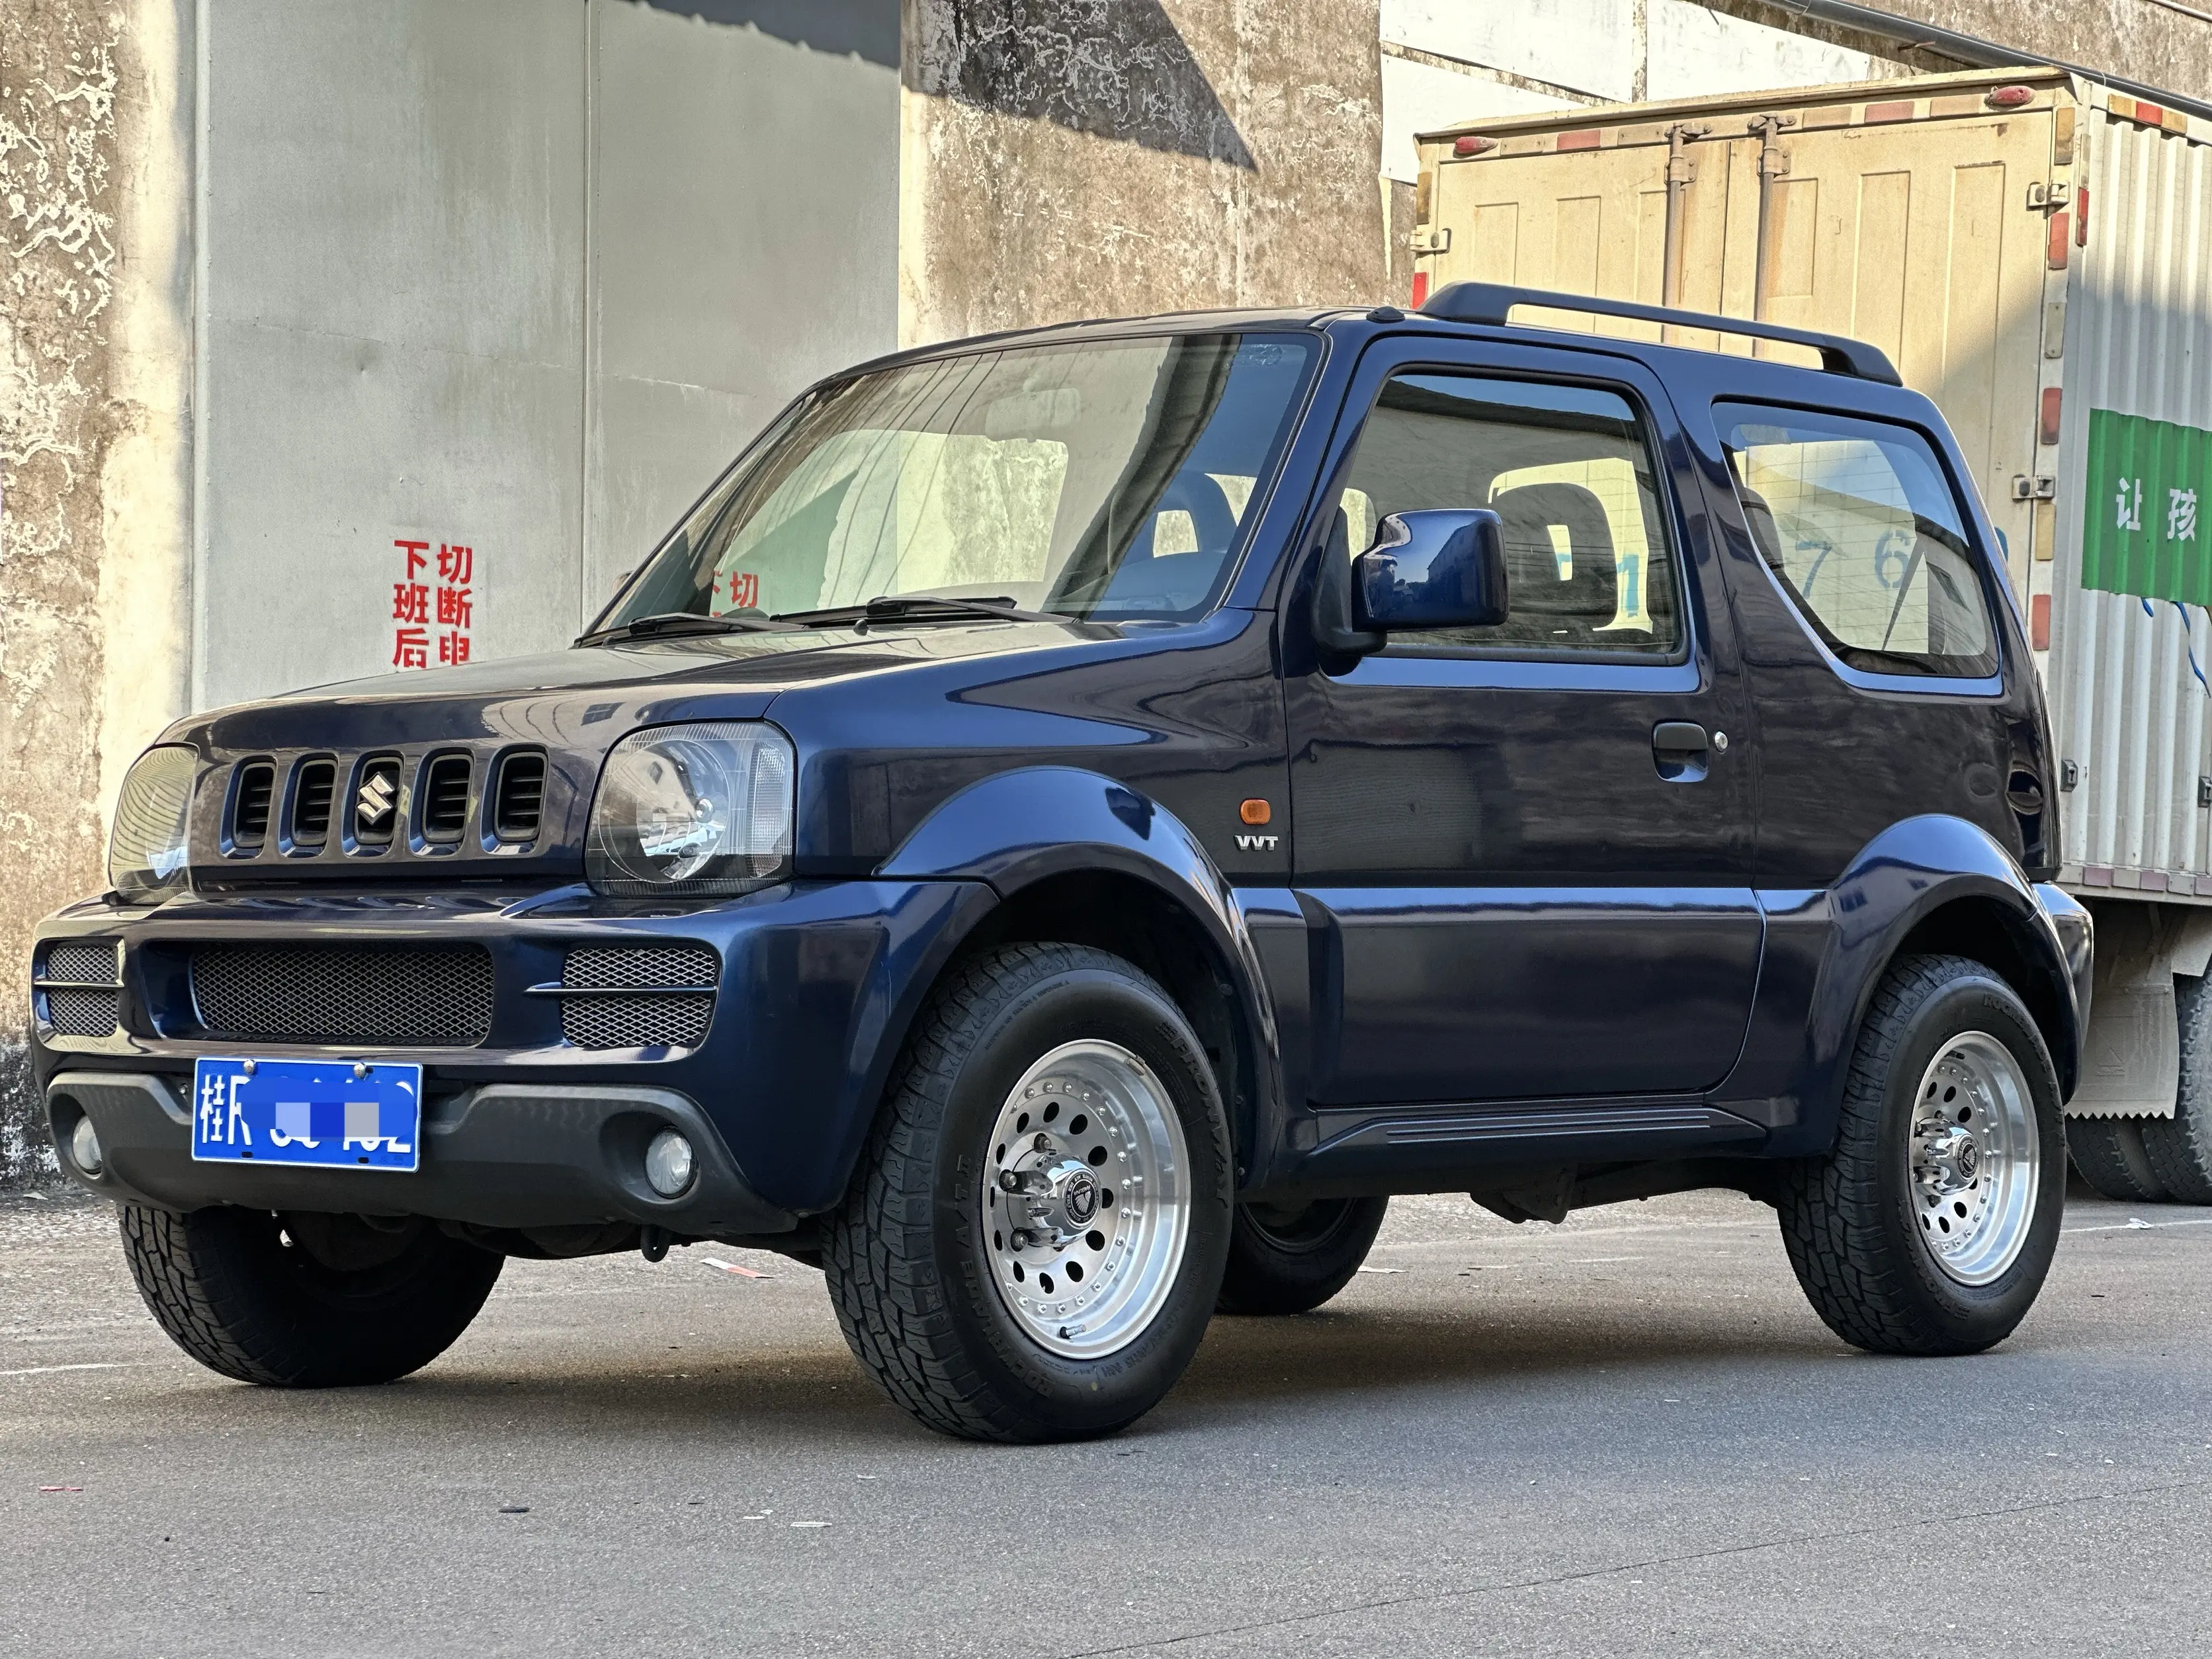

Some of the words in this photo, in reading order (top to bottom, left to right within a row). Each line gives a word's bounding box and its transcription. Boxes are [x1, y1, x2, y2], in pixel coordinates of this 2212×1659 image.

[392, 540, 429, 669] 下班后
[1234, 835, 1279, 851] VVT
